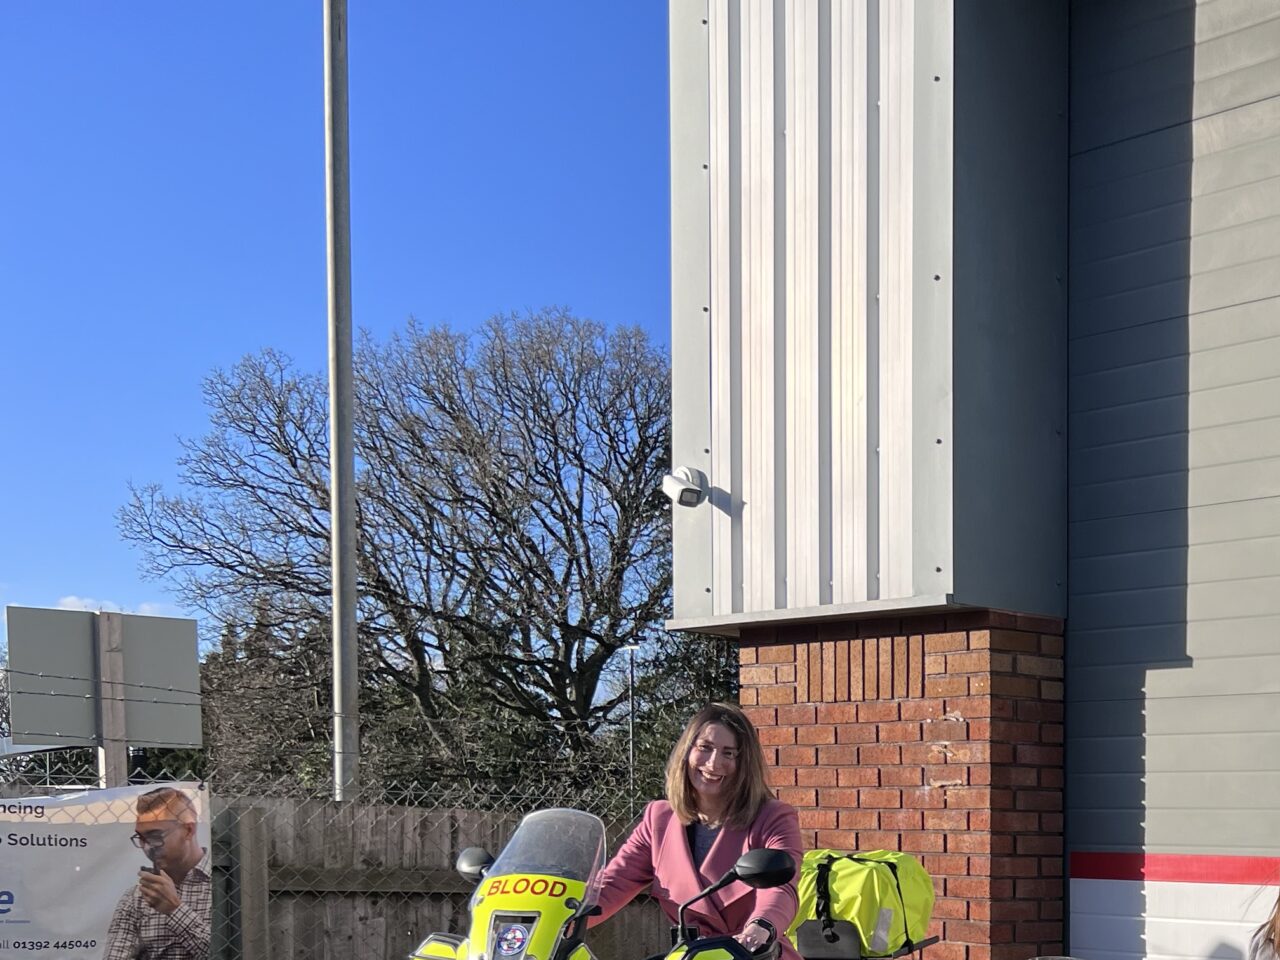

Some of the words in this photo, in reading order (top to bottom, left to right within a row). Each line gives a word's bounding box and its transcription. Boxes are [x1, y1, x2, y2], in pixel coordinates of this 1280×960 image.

[7, 833, 88, 848] Solutions
[487, 878, 567, 898] BLOOD
[13, 940, 49, 950] 01392
[53, 939, 97, 950] 445040
